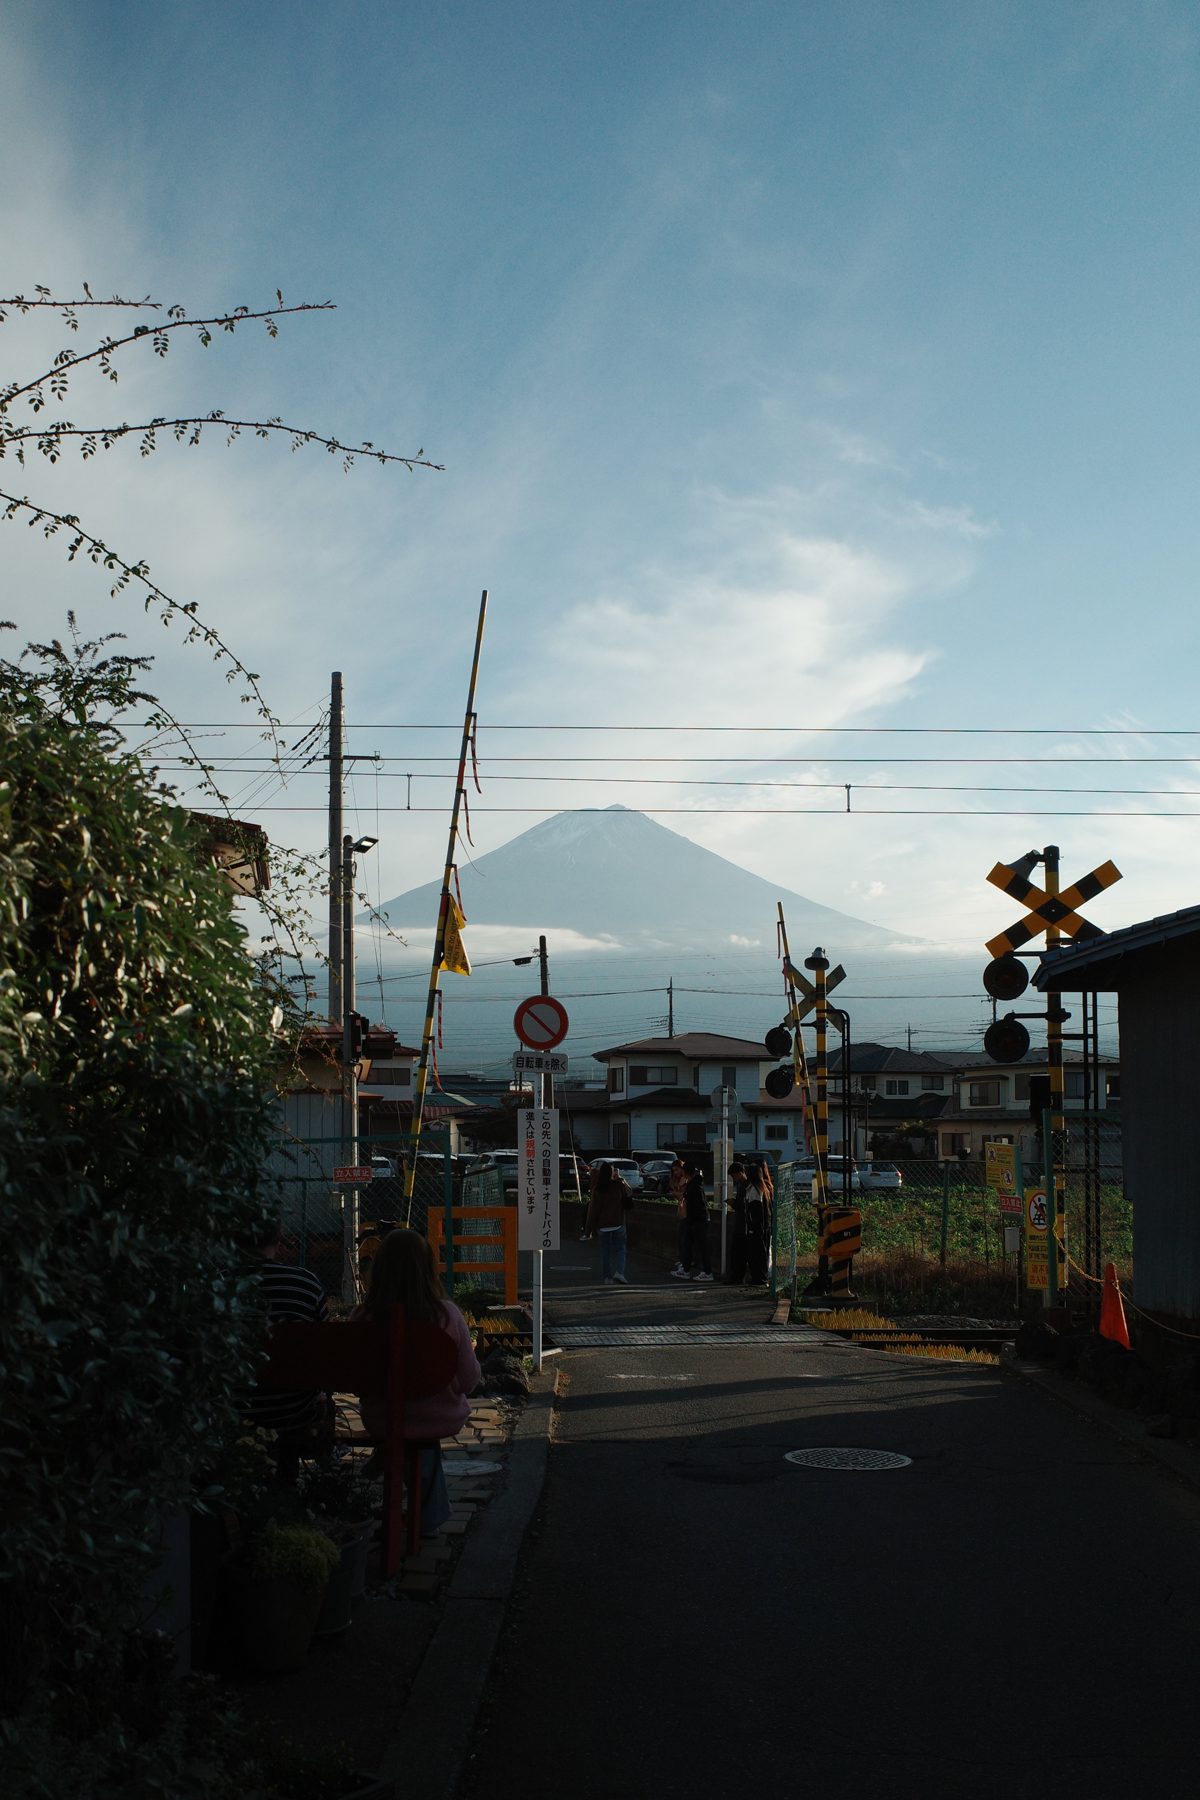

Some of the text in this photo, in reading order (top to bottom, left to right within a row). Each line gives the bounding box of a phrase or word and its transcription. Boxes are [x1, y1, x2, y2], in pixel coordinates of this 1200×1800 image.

[516, 1056, 566, 1072] 自転車を除く
[336, 1169, 369, 1177] 立入禁止
[525, 1111, 535, 1215] 進入は規制されています
[541, 1111, 552, 1248] この先への自動車・オートバイの
